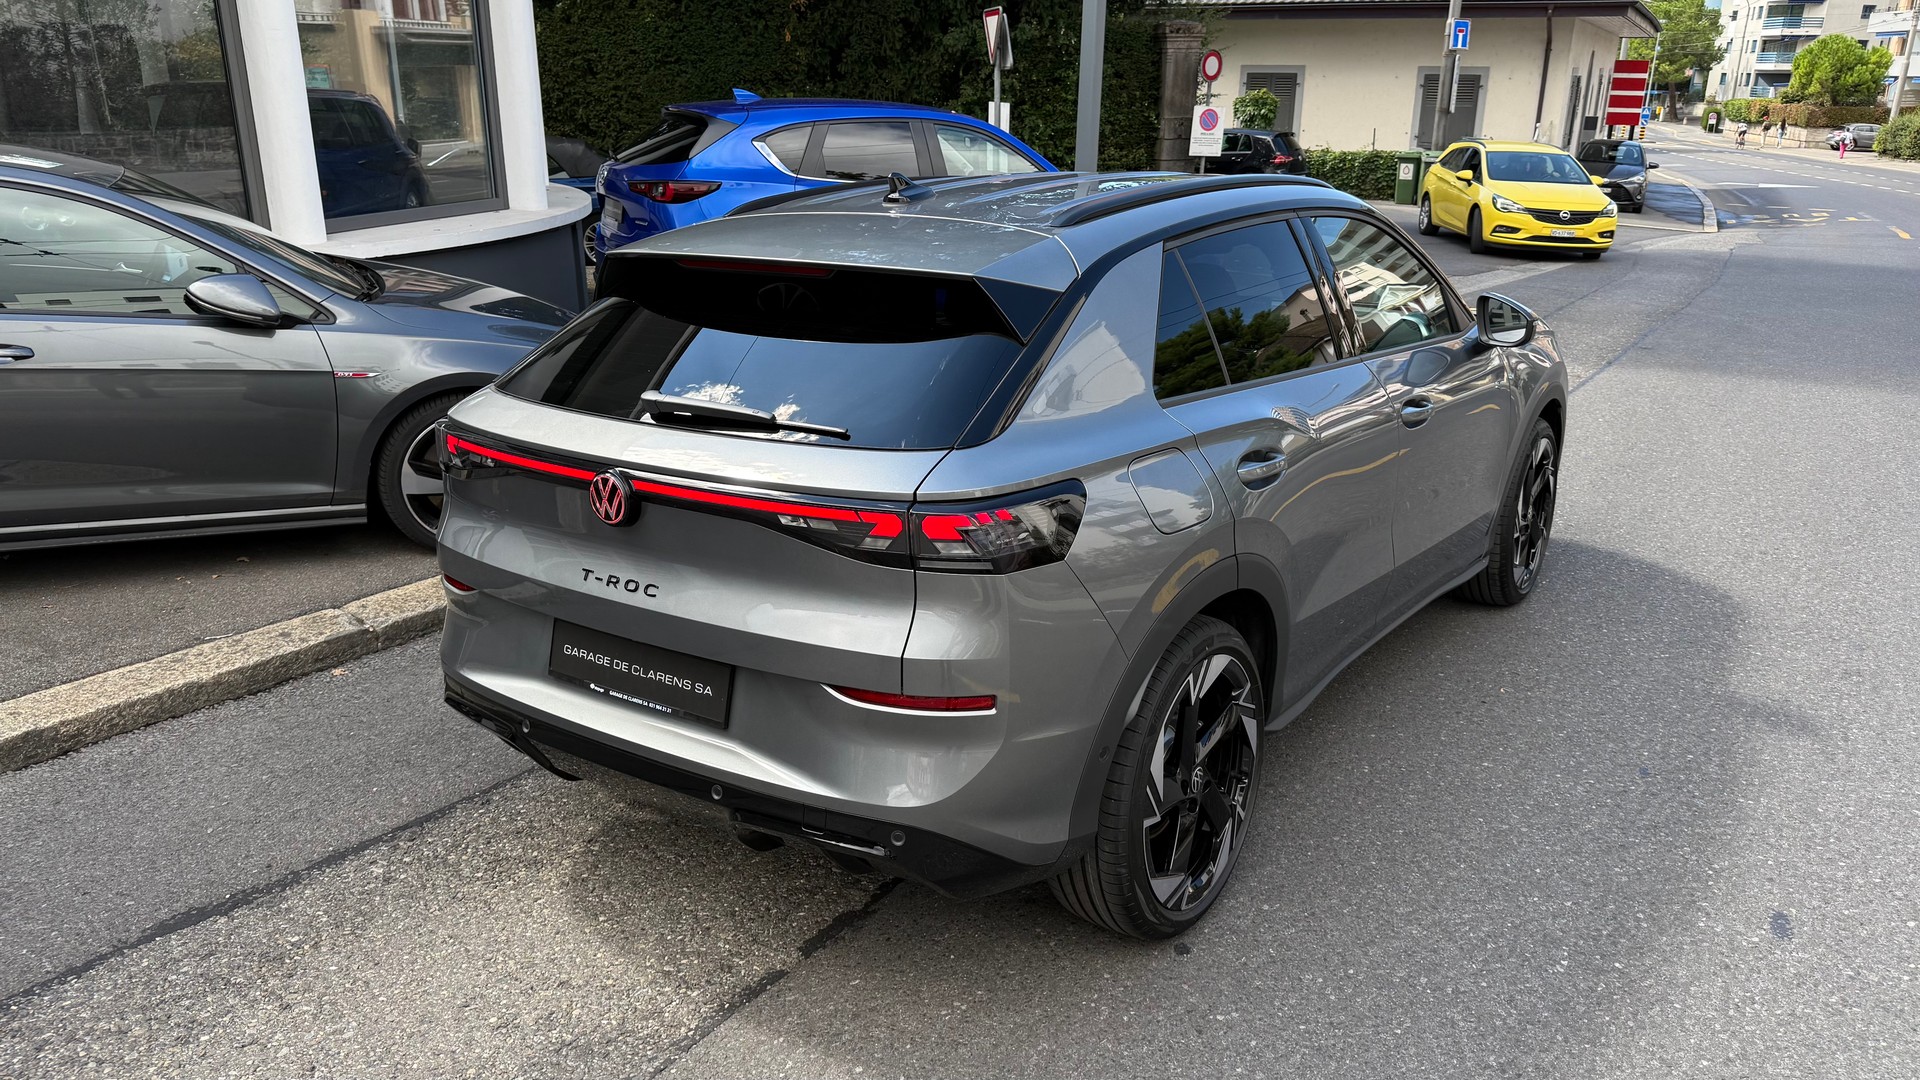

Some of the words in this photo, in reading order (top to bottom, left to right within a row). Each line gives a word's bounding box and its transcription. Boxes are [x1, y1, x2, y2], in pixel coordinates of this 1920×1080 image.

[582, 568, 659, 597] T-ROC
[563, 644, 611, 667] GARAGE
[613, 659, 629, 673] DE
[631, 665, 692, 690] CLARENS
[694, 683, 713, 697] SA
